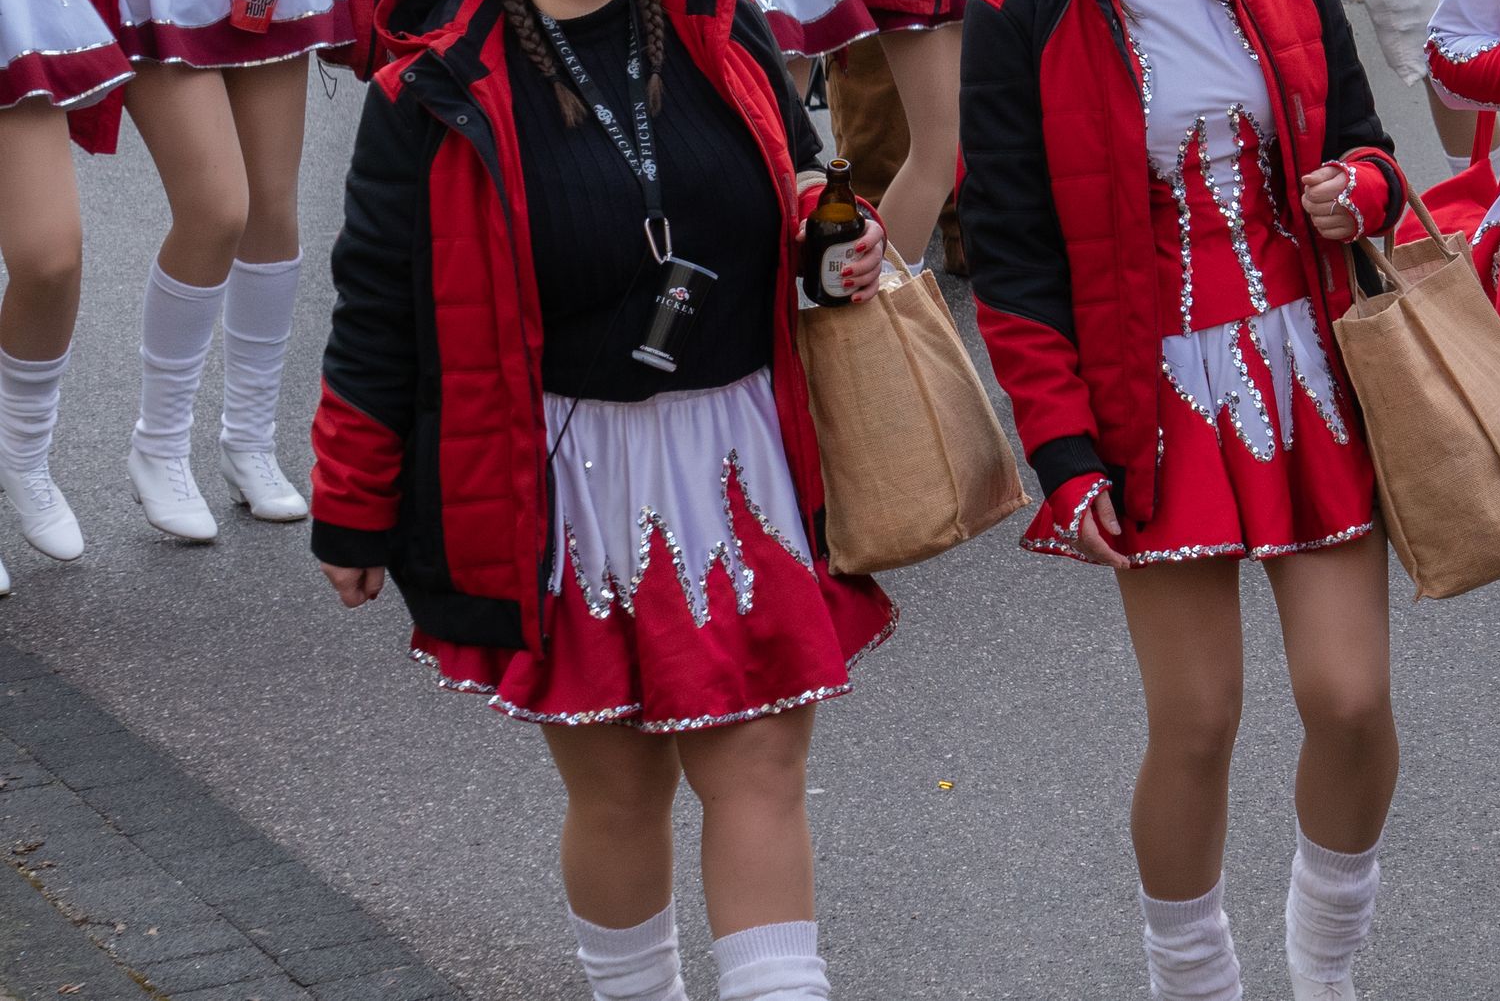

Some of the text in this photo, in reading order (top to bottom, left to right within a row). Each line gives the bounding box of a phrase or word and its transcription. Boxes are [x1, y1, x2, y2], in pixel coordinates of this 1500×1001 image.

[246, 3, 267, 18] HUH
[551, 31, 590, 85] FICKEN
[608, 126, 643, 177] FICKEN
[634, 101, 653, 156] FICKEN
[655, 294, 696, 316] FICKEN
